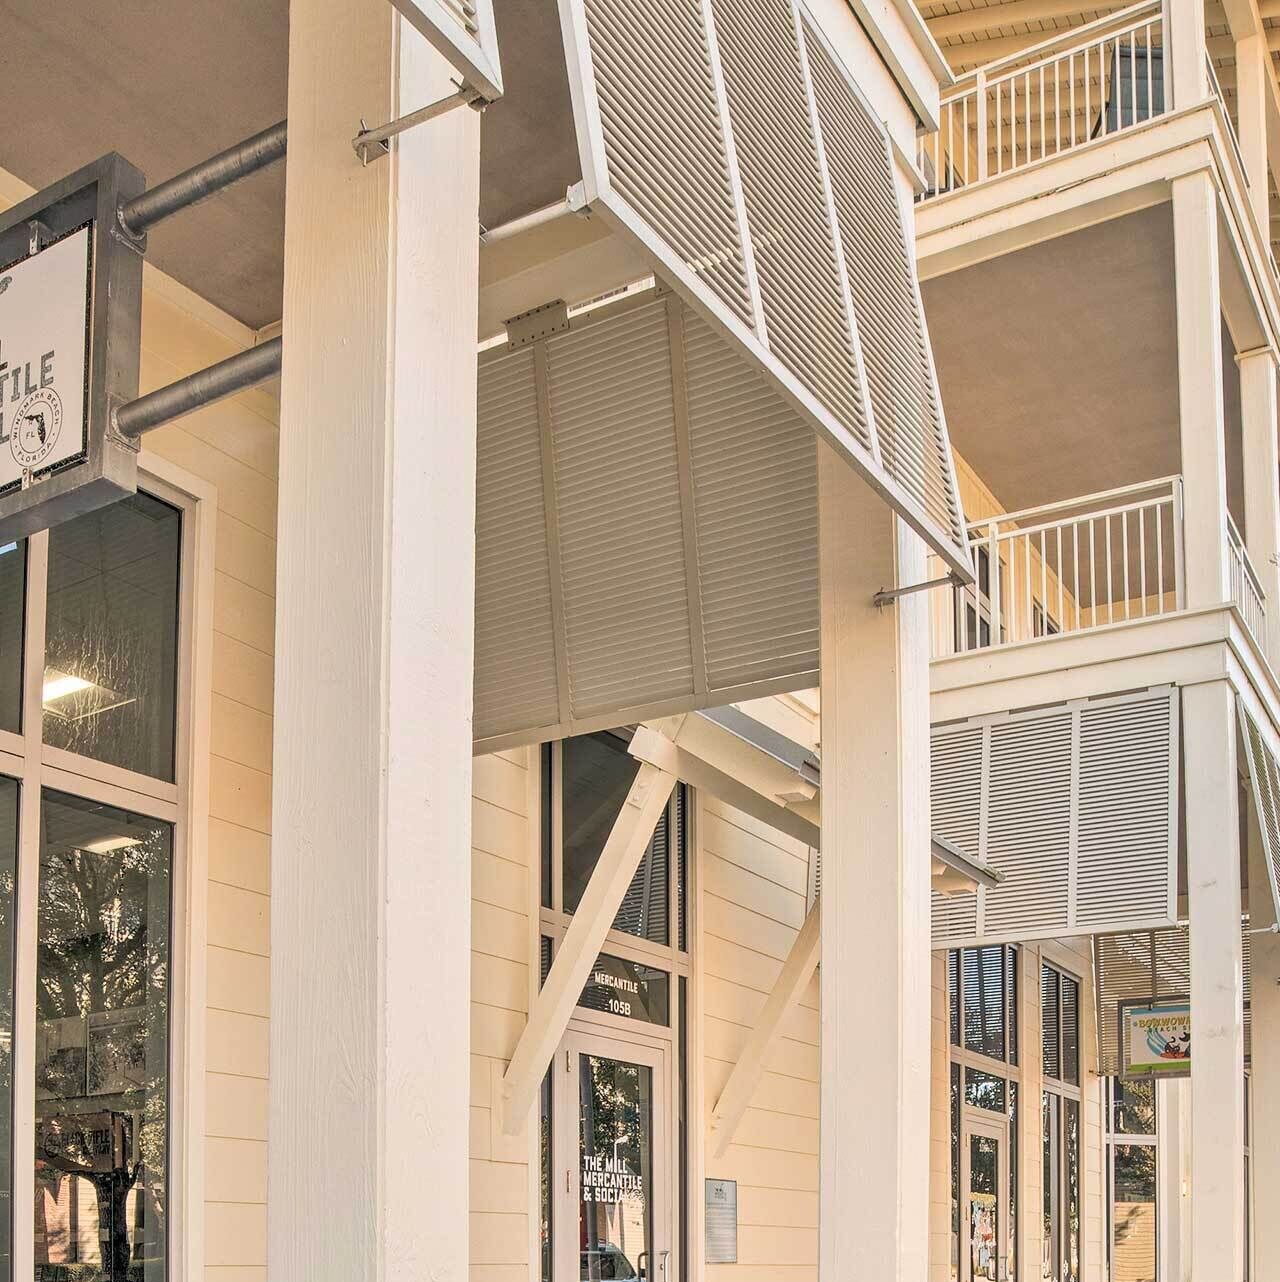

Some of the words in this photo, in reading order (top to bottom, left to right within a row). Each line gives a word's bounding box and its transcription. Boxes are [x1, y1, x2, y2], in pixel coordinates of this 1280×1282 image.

[594, 972, 638, 993] MERCANTILE
[609, 999, 631, 1016] 105B
[1139, 1016, 1190, 1028] BOWWOW
[583, 1156, 602, 1171] THE
[605, 1143, 627, 1173] MILL
[583, 1171, 642, 1190] MERCANTILE
[583, 1187, 592, 1202] &
[595, 1188, 628, 1203] SOCIA
